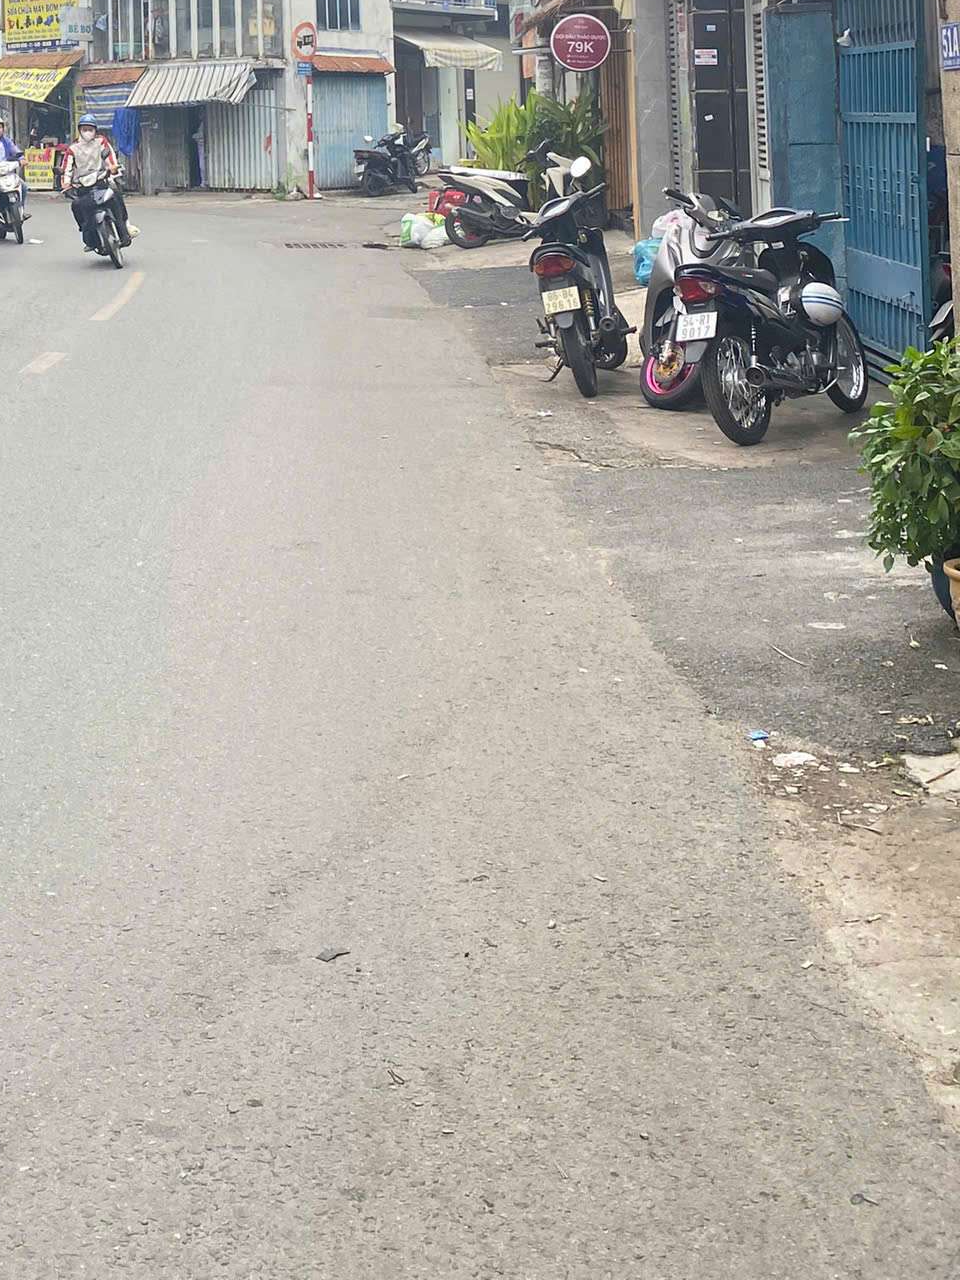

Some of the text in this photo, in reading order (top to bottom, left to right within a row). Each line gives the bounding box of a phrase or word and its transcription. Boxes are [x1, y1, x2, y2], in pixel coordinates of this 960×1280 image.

[567, 41, 594, 53] 79K
[942, 26, 960, 58] 51A
[681, 325, 711, 339] 9017
